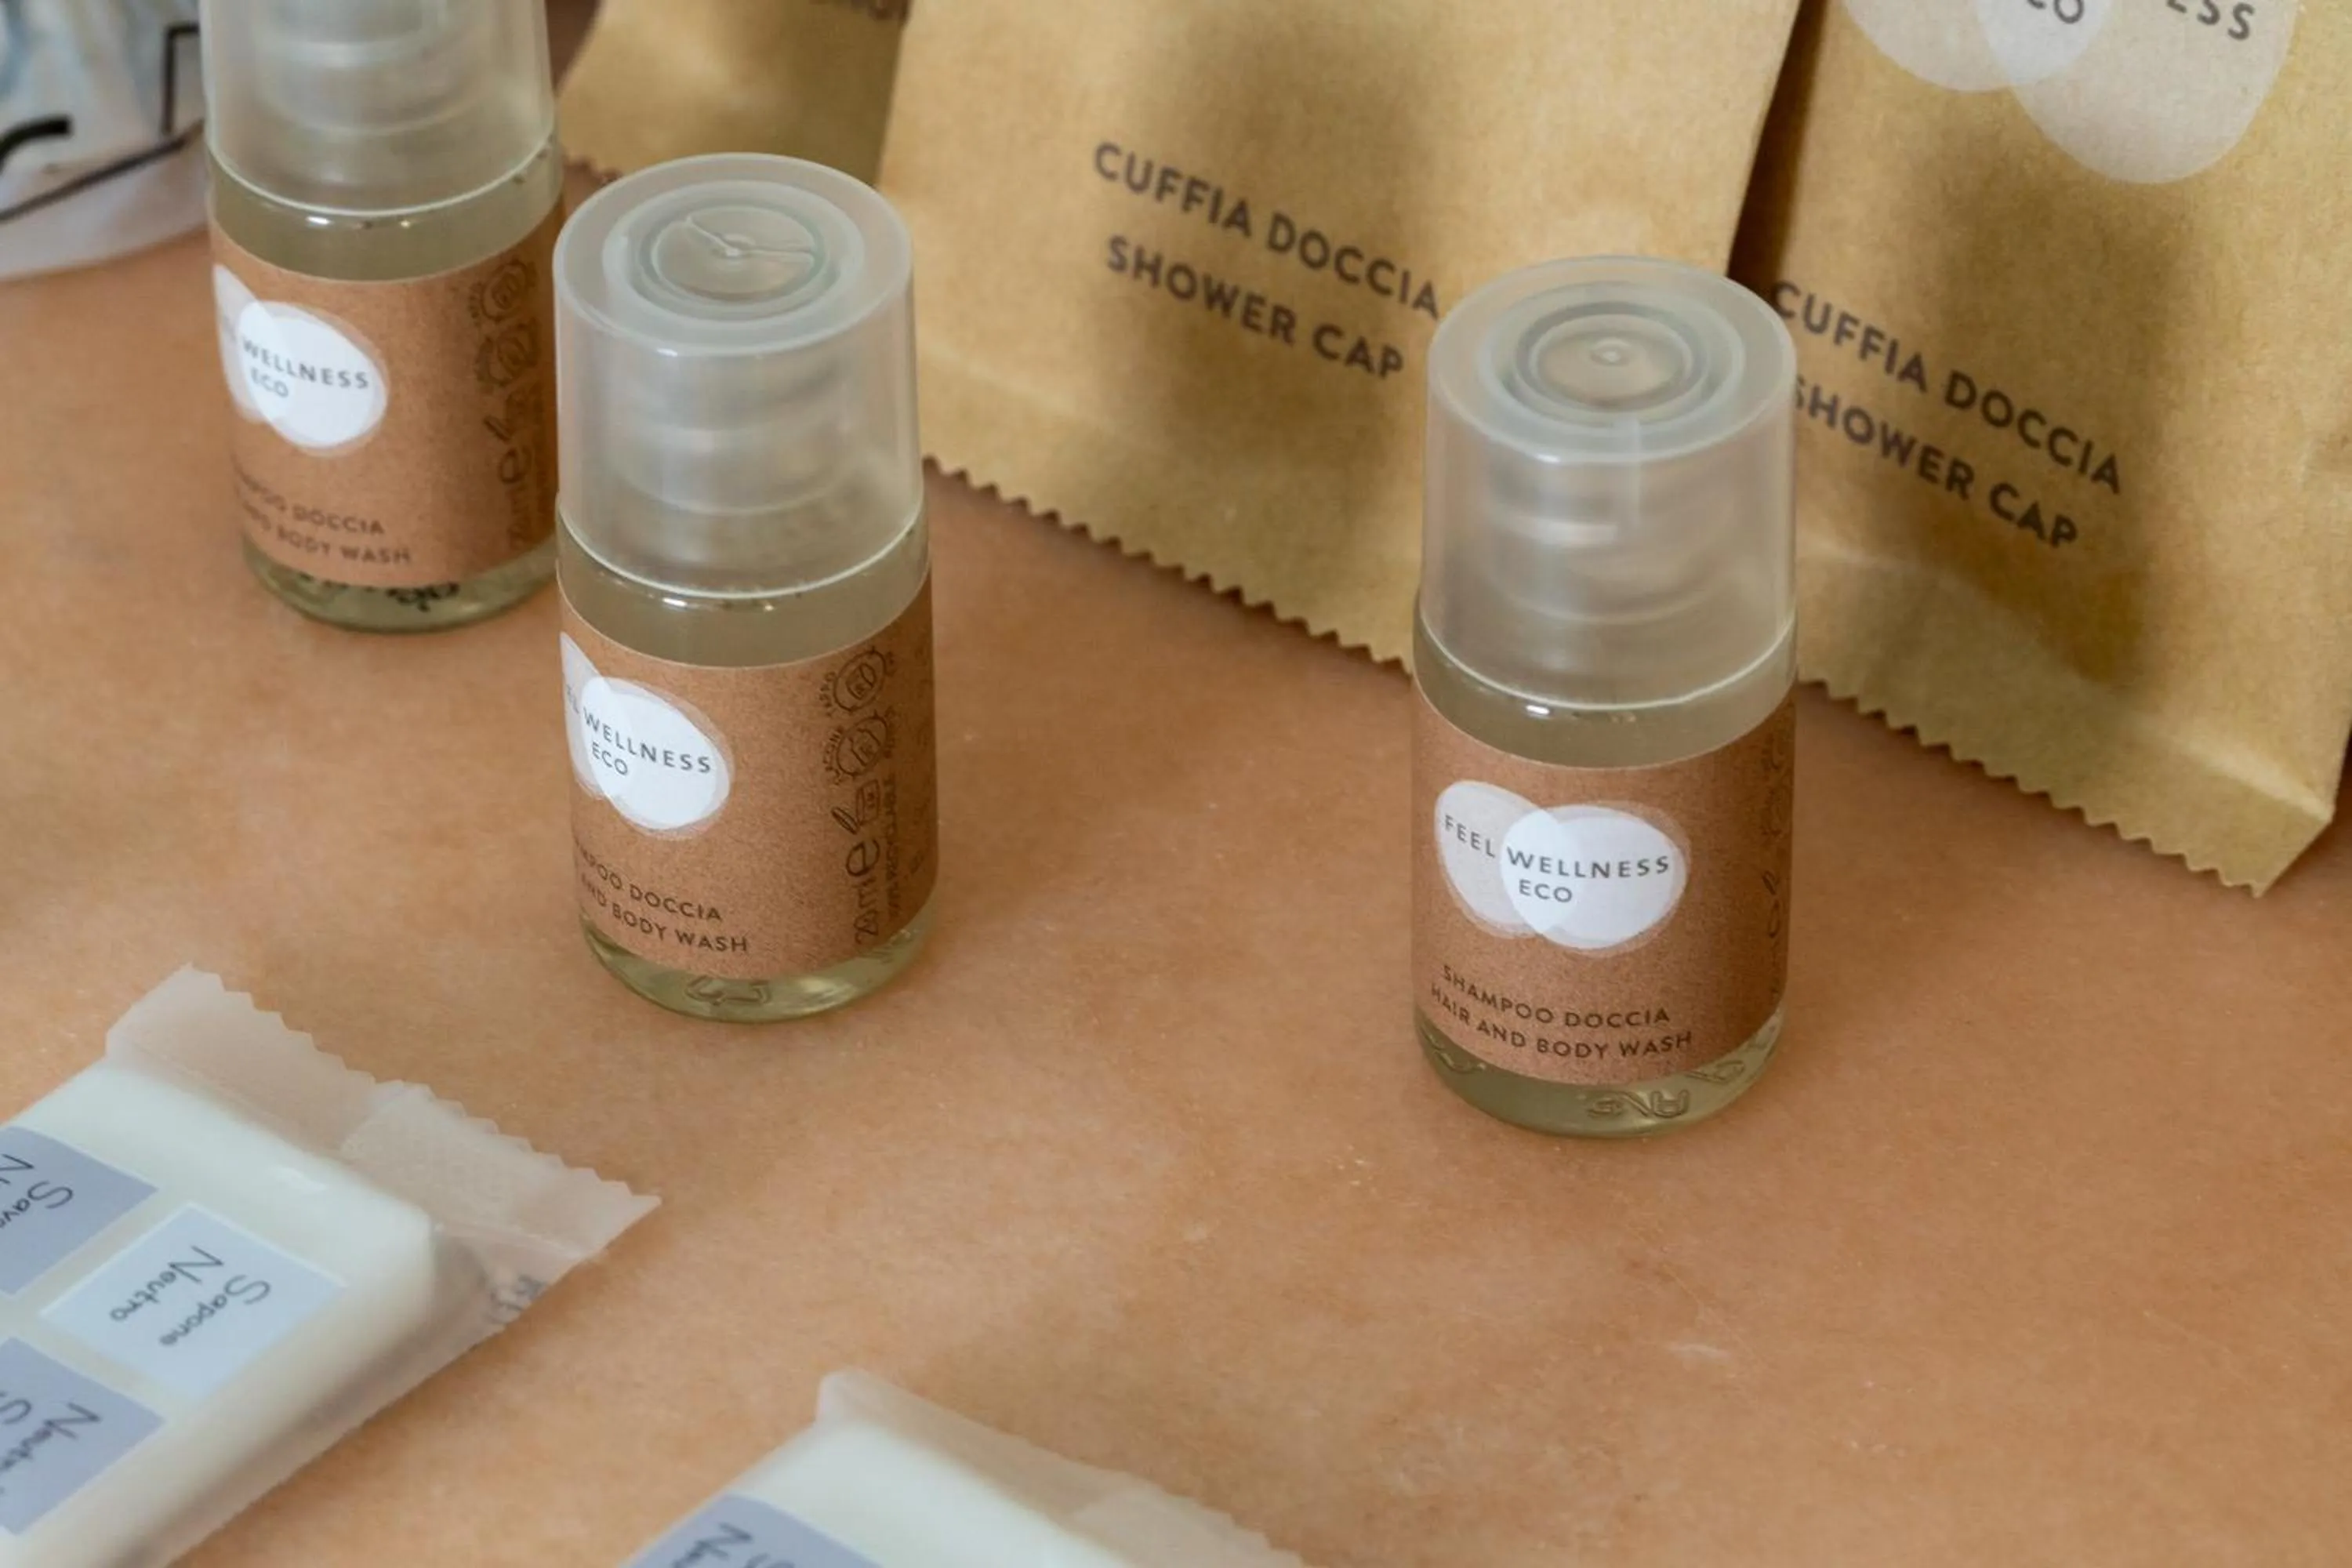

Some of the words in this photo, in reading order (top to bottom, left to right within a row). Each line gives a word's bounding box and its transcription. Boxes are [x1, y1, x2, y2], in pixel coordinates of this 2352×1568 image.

[1094, 141, 1252, 238] CUFFIA
[1266, 211, 1439, 321] DOCCIA
[1107, 235, 1297, 347] SHOWER
[1312, 322, 1404, 379] CAP
[242, 335, 369, 390] WELLNESS
[250, 366, 289, 398] ECO
[1773, 279, 1928, 394] CUFFIA
[1944, 369, 2121, 495] DOCCIA
[292, 503, 385, 535] DOCCIA
[1989, 482, 2078, 548] CAP
[583, 706, 712, 774] WELLNESS
[592, 741, 630, 776] ECO
[1443, 814, 1496, 858] FEEL
[1506, 846, 1671, 879] WELLNESS
[630, 883, 722, 922] DOCCIA
[1518, 878, 1573, 903] ECO
[612, 902, 667, 941] BODY
[674, 929, 748, 953] WASH
[1430, 982, 1470, 1025] HAIR
[1476, 1020, 1526, 1048] AND
[1536, 1038, 1609, 1059] BODY
[1619, 1031, 1692, 1057] WASH
[1443, 964, 1555, 1024] SHAMPOO
[1564, 1007, 1671, 1029] DOCCIA
[109, 1245, 224, 1322] Neutro
[159, 1274, 271, 1347] Sapone
